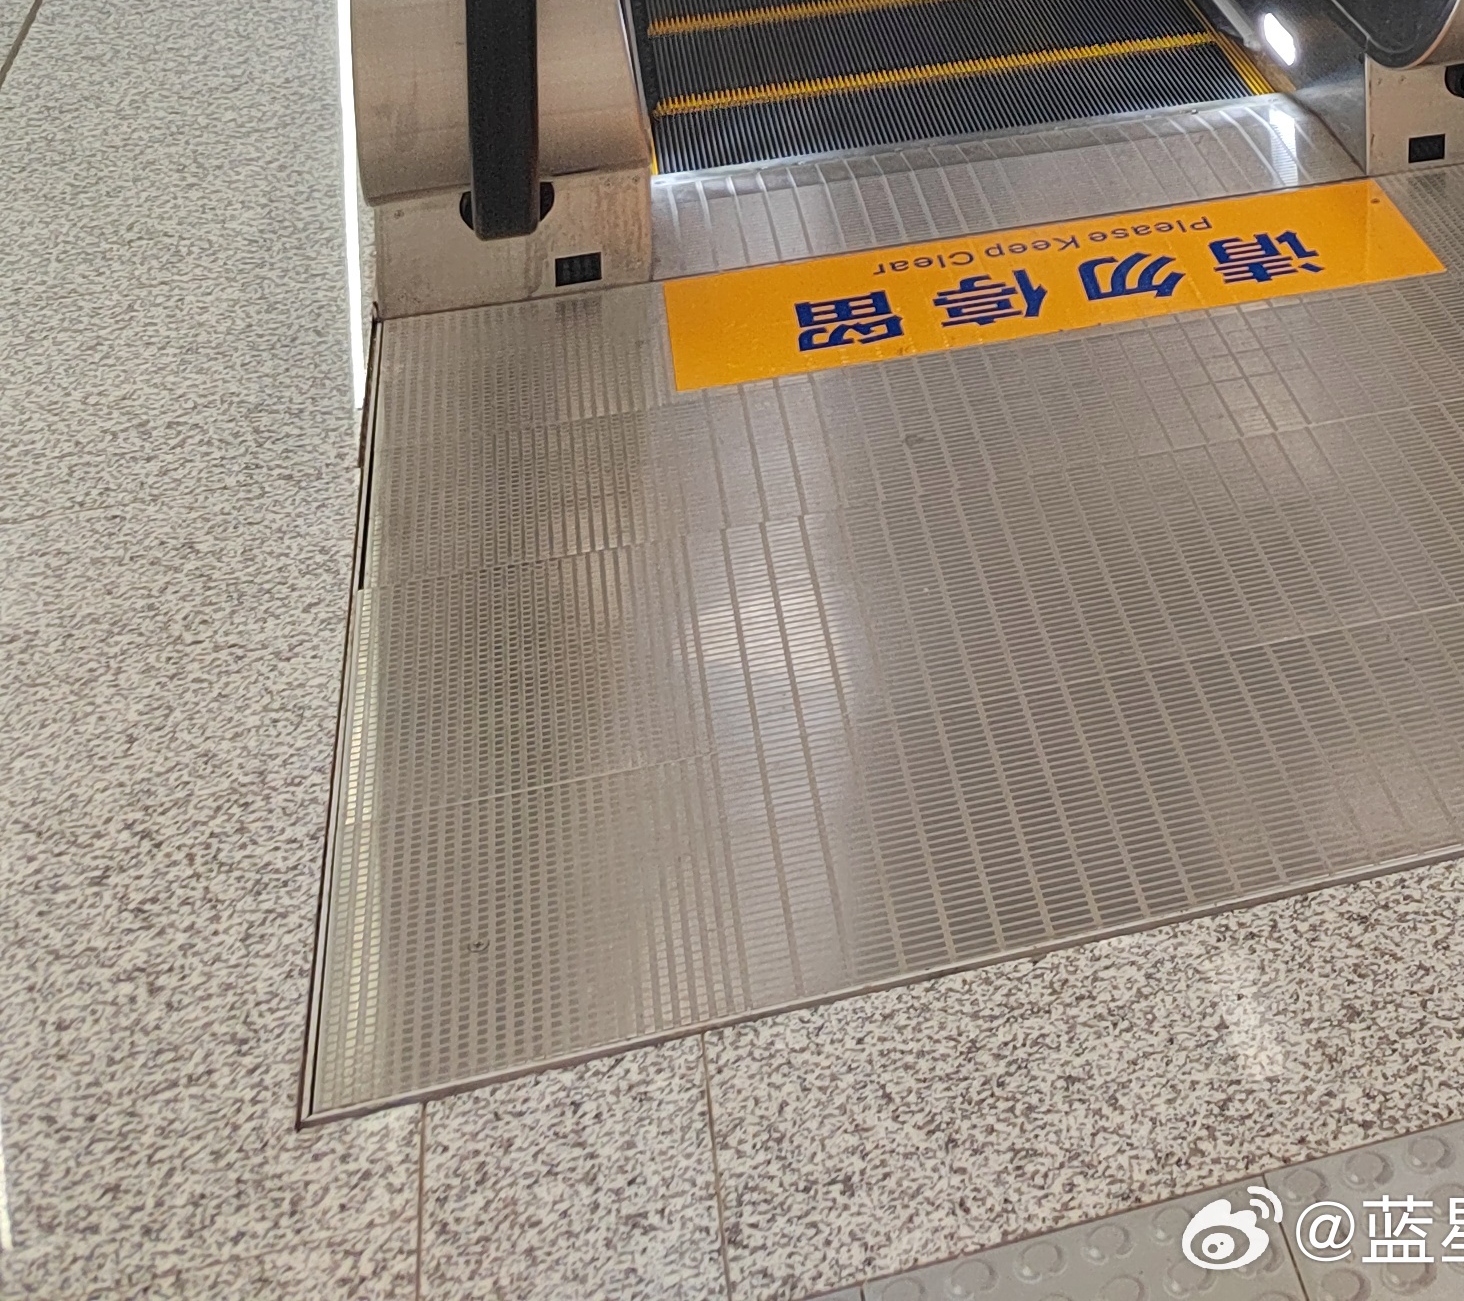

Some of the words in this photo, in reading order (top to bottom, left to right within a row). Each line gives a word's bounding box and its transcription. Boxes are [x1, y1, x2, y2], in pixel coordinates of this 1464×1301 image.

[1088, 215, 1213, 242] Please
[984, 234, 1081, 258] Keep
[873, 250, 975, 276] Clear
[795, 230, 1328, 352] 请勿停留
